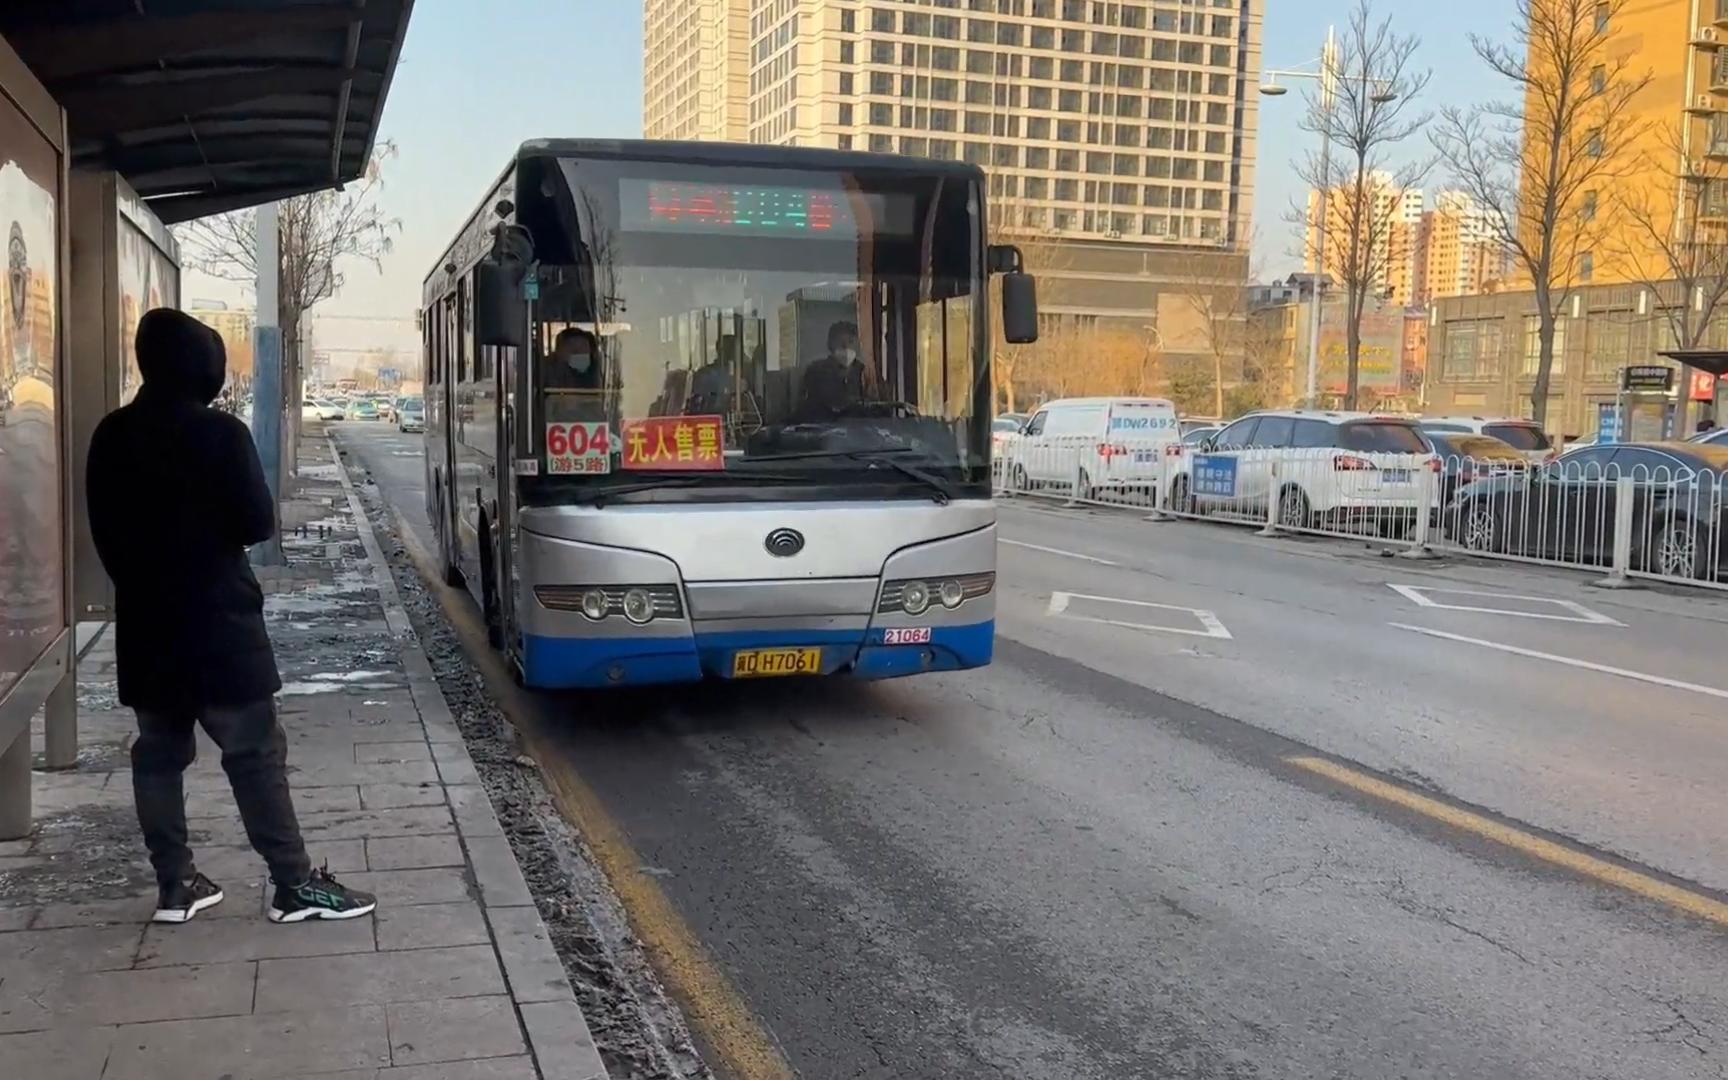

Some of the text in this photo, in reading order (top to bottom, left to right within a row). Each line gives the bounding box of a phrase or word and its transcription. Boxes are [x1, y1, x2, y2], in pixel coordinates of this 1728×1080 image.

[549, 424, 609, 457] 604
[629, 423, 719, 463] 无人售票
[886, 630, 929, 643] 21064
